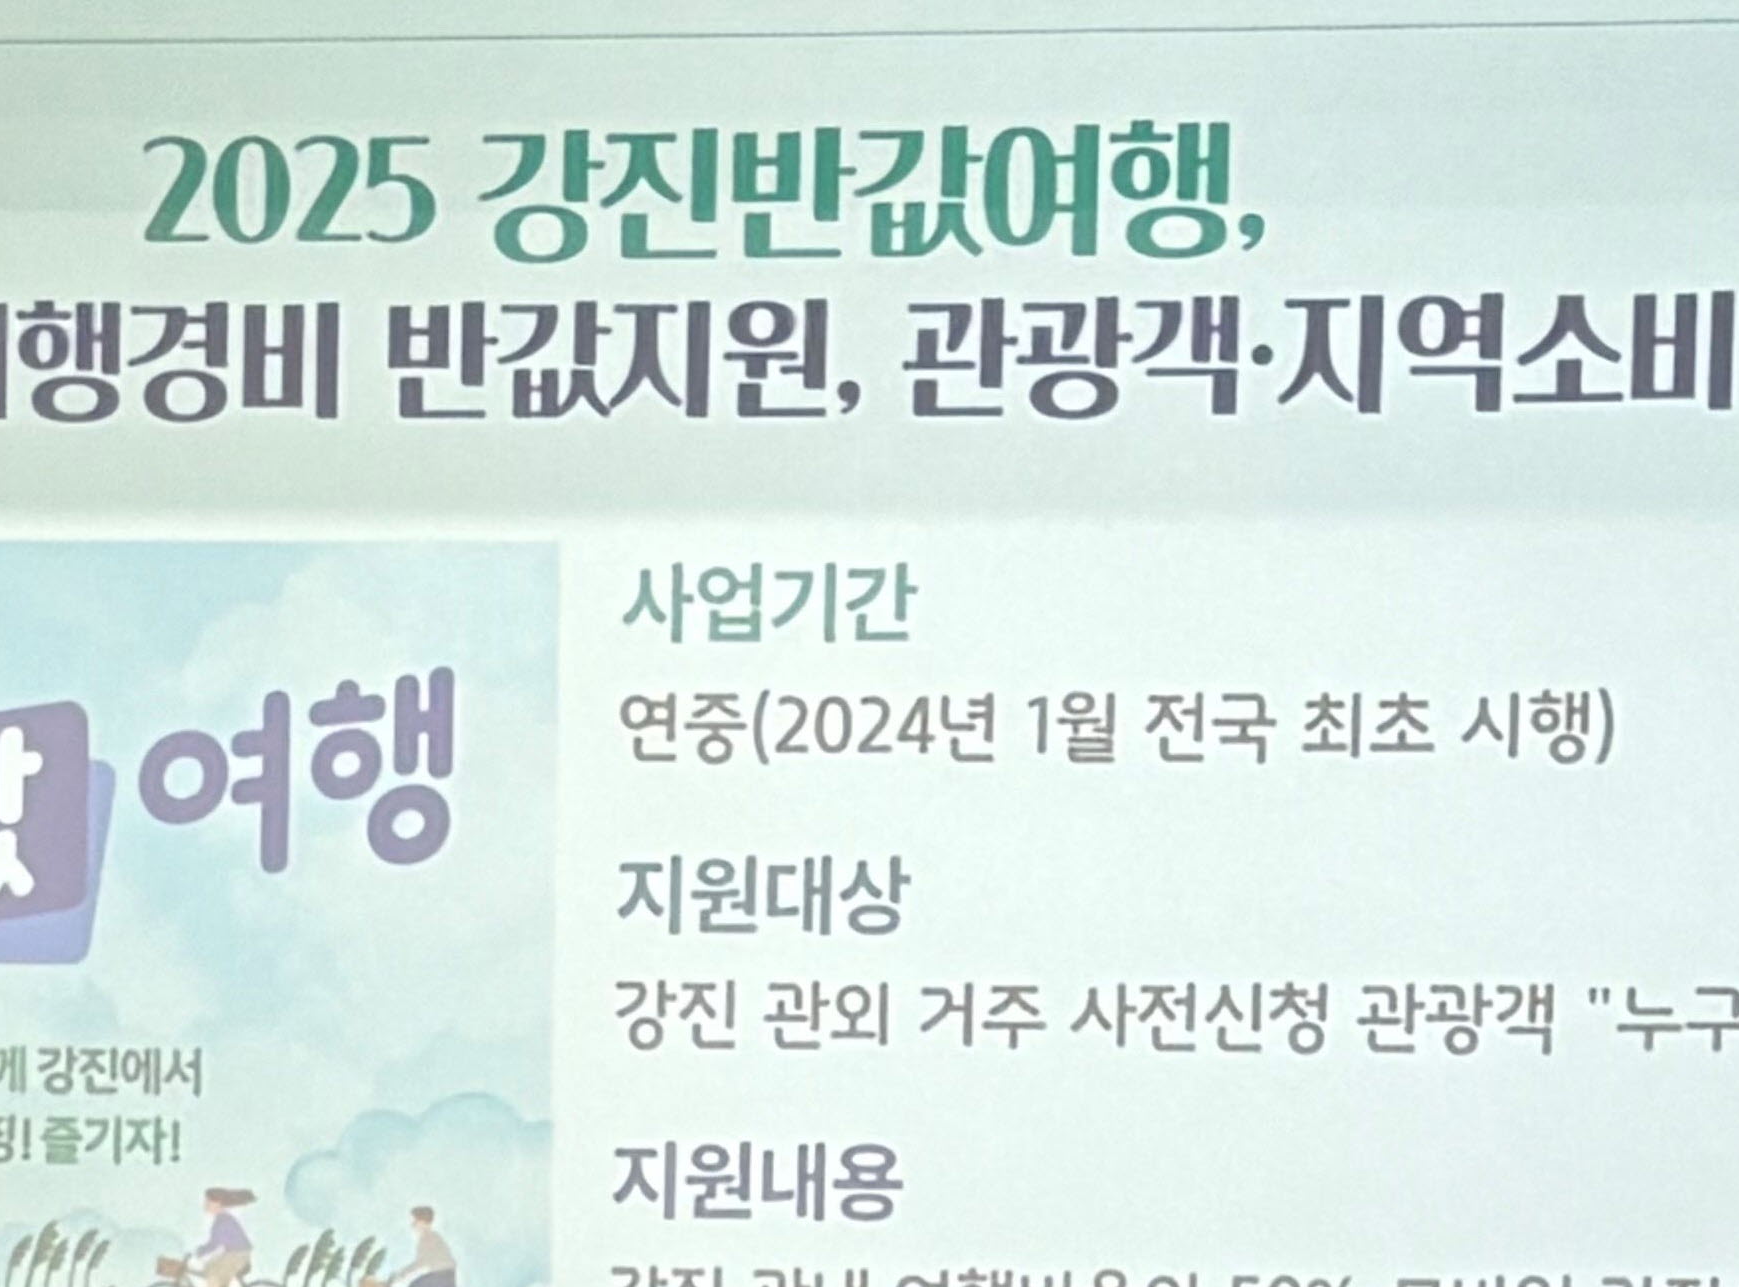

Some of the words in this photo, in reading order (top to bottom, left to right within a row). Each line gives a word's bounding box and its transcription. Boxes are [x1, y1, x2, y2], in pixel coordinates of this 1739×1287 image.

[143, 135, 435, 243] 2025
[478, 120, 1264, 263] 강진반값여행,
[388, 299, 860, 418] 반값지원,
[623, 562, 918, 643] 사업기간
[620, 690, 994, 765] 연중(2024년
[1028, 692, 1115, 763] 1월
[1146, 692, 1277, 764] 전국
[1302, 692, 1434, 758] 최초
[1462, 688, 1614, 764] 시행)
[138, 666, 454, 874] 여행
[618, 855, 911, 935] 지원대상
[616, 980, 735, 1050] 강진
[764, 981, 888, 1050] 관외
[921, 982, 1046, 1049] 거주
[1070, 982, 1328, 1054] 사전신청
[1357, 983, 1554, 1055] 관광객
[38, 1046, 202, 1097] 강진에서
[41, 1116, 180, 1165] 즐기자!
[613, 1141, 903, 1221] 지원내용
